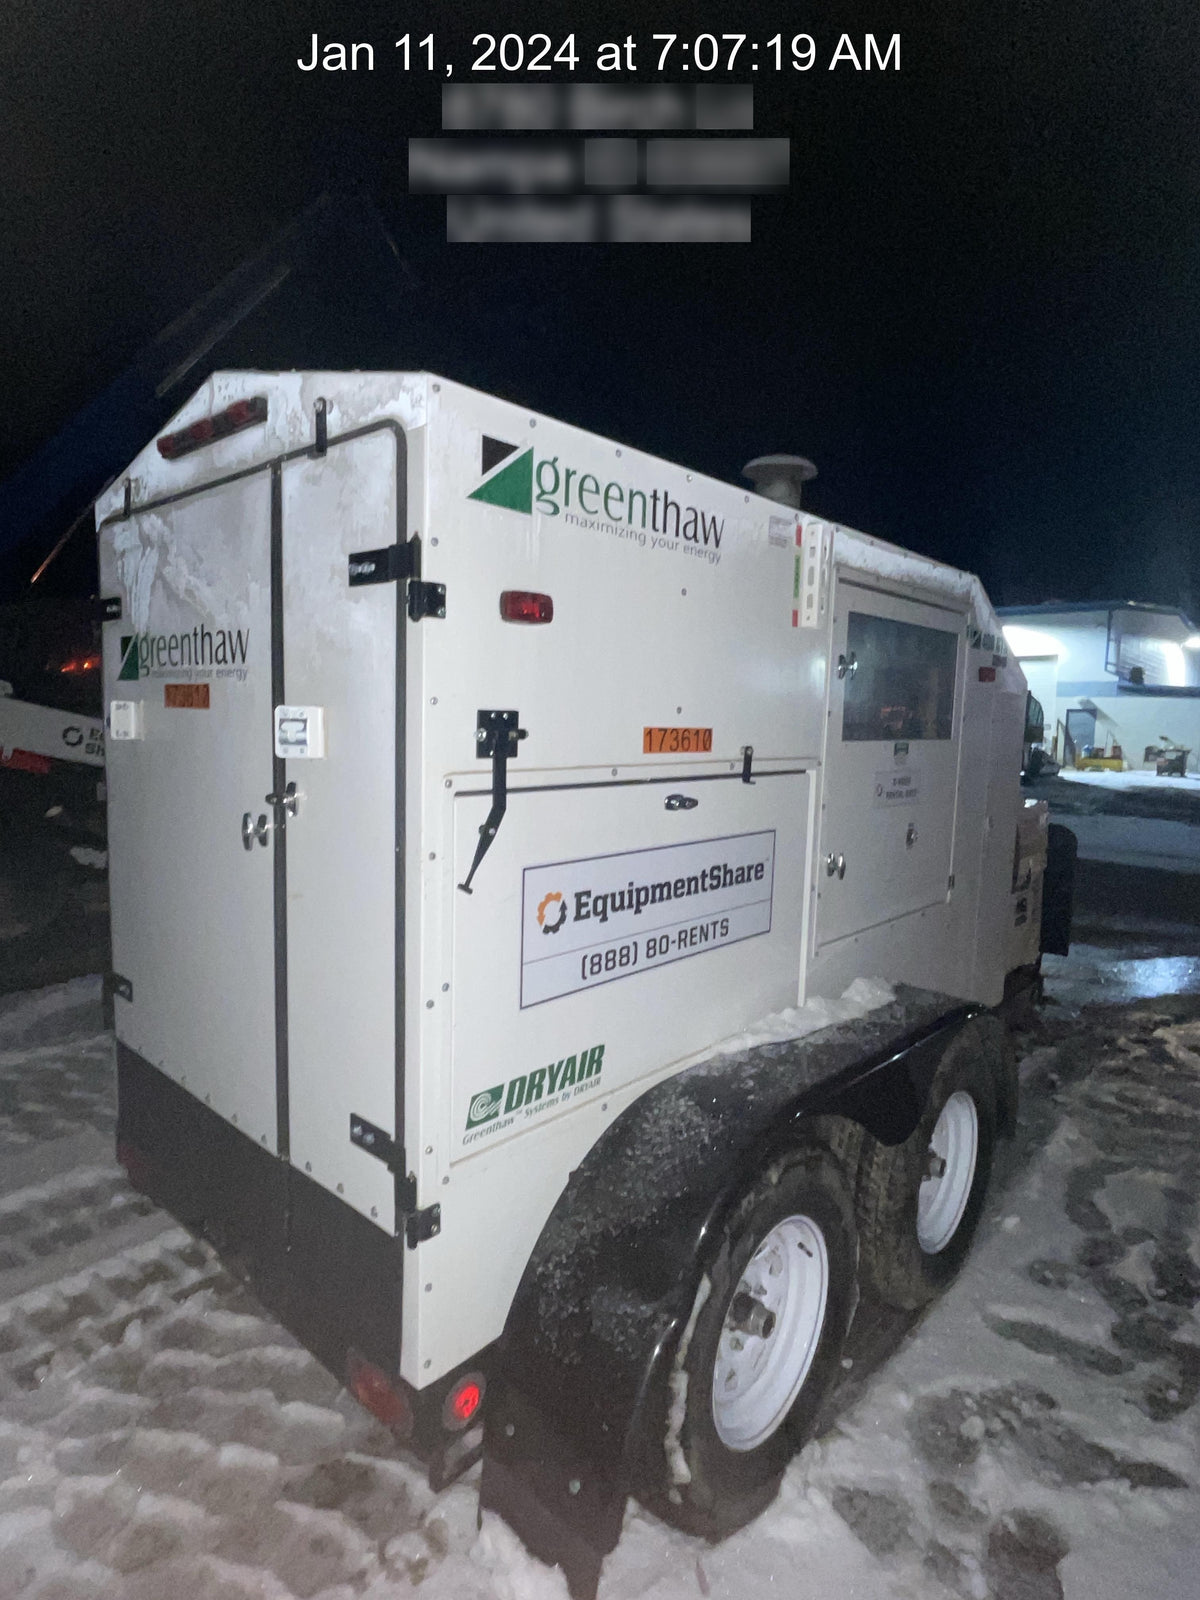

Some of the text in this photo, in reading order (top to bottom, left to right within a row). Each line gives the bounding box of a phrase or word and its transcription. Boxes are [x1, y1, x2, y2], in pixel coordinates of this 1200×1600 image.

[535, 456, 725, 549] greenthaw
[565, 512, 722, 566] maximizing your energy
[139, 623, 250, 677] greenthaw
[645, 728, 712, 752] 173610
[573, 862, 765, 922] EquipmentShare
[581, 918, 730, 980] (888) 80-RENTS
[504, 1044, 605, 1114] DRYAIR
[524, 1097, 559, 1119] Systems
[561, 1091, 572, 1102] by
[573, 1077, 601, 1096] DRYAIR
